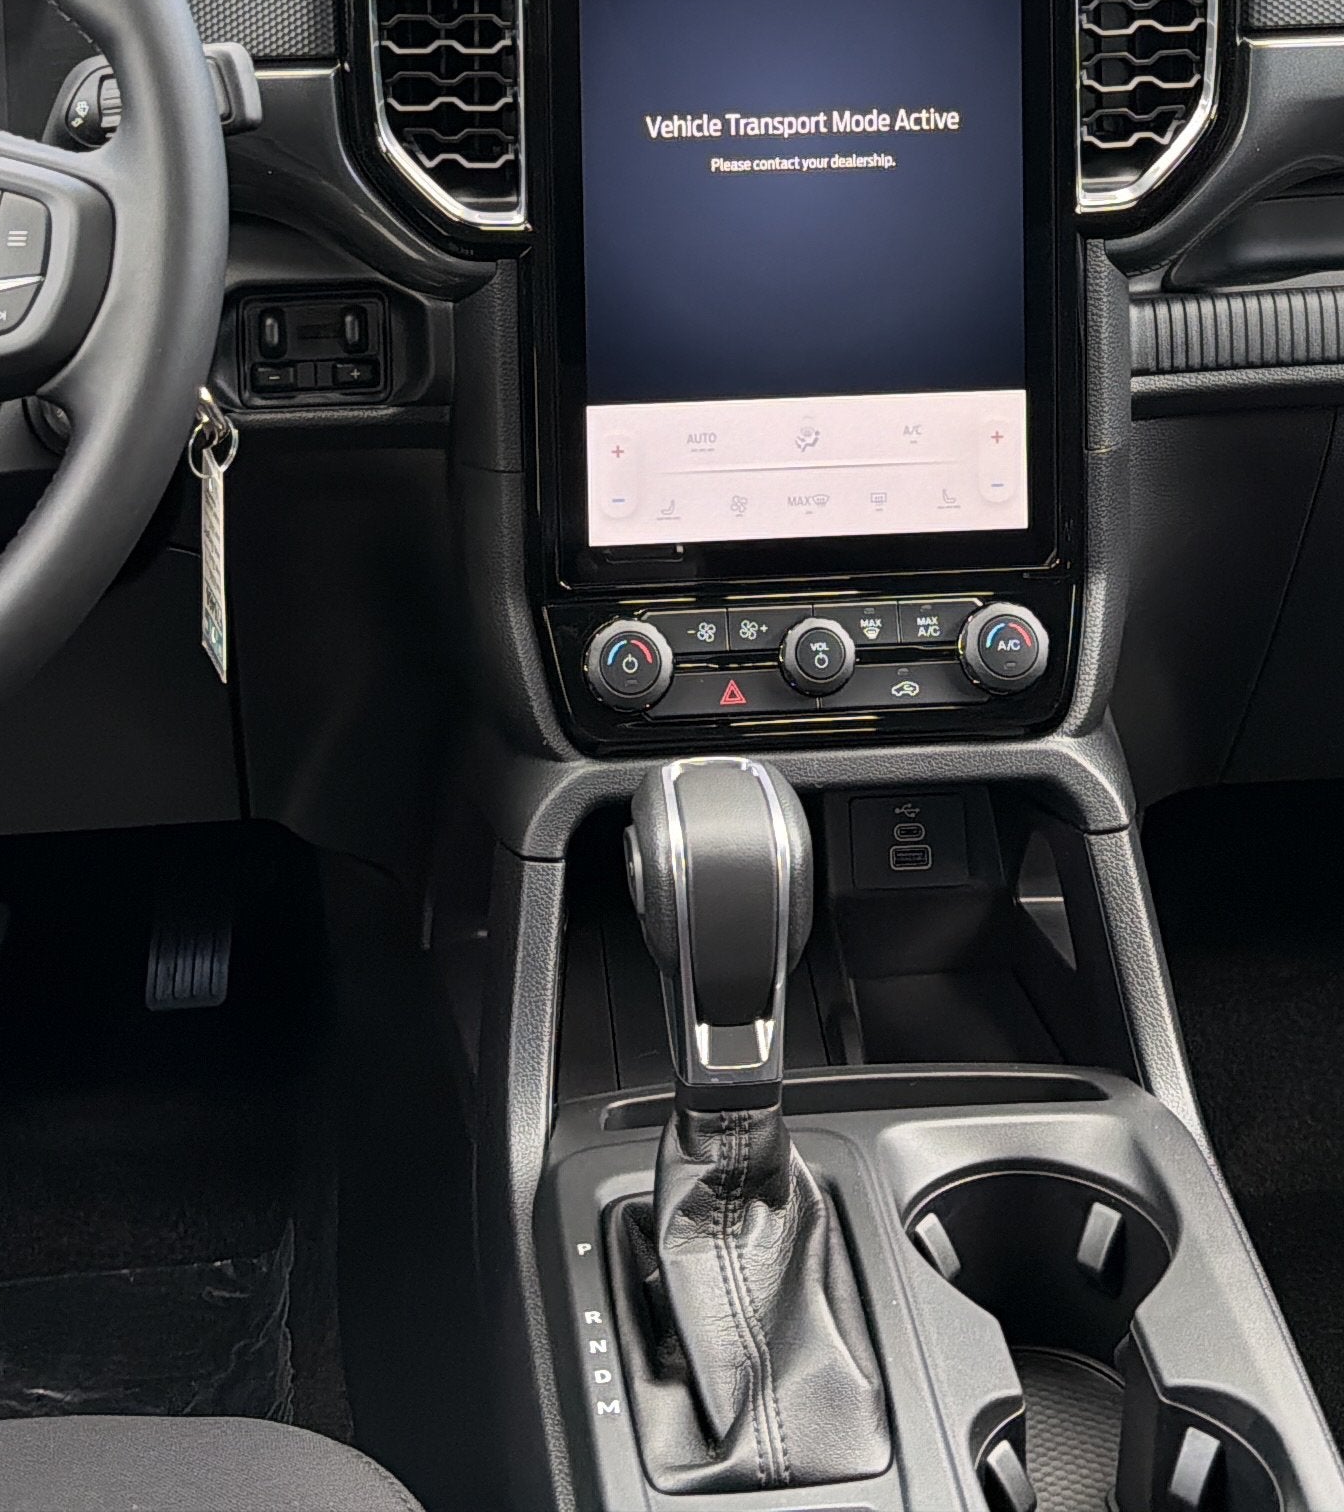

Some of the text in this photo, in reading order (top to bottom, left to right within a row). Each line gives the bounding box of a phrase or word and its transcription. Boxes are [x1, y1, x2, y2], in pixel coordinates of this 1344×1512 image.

[645, 108, 960, 138] Vehicle Transport Mode Active
[710, 153, 896, 173] Please contact your dealership.
[903, 424, 923, 437] A/C
[686, 432, 717, 445] AUTO
[787, 496, 812, 507] MAX
[860, 618, 882, 628] MAX
[916, 616, 939, 626] MAX
[917, 626, 941, 637] A/C
[810, 642, 830, 652] VOL
[997, 640, 1021, 652] A/C
[576, 1243, 592, 1256] P
[584, 1310, 602, 1325] R
[589, 1339, 607, 1354] N
[594, 1369, 612, 1384] D
[596, 1399, 621, 1415] M
